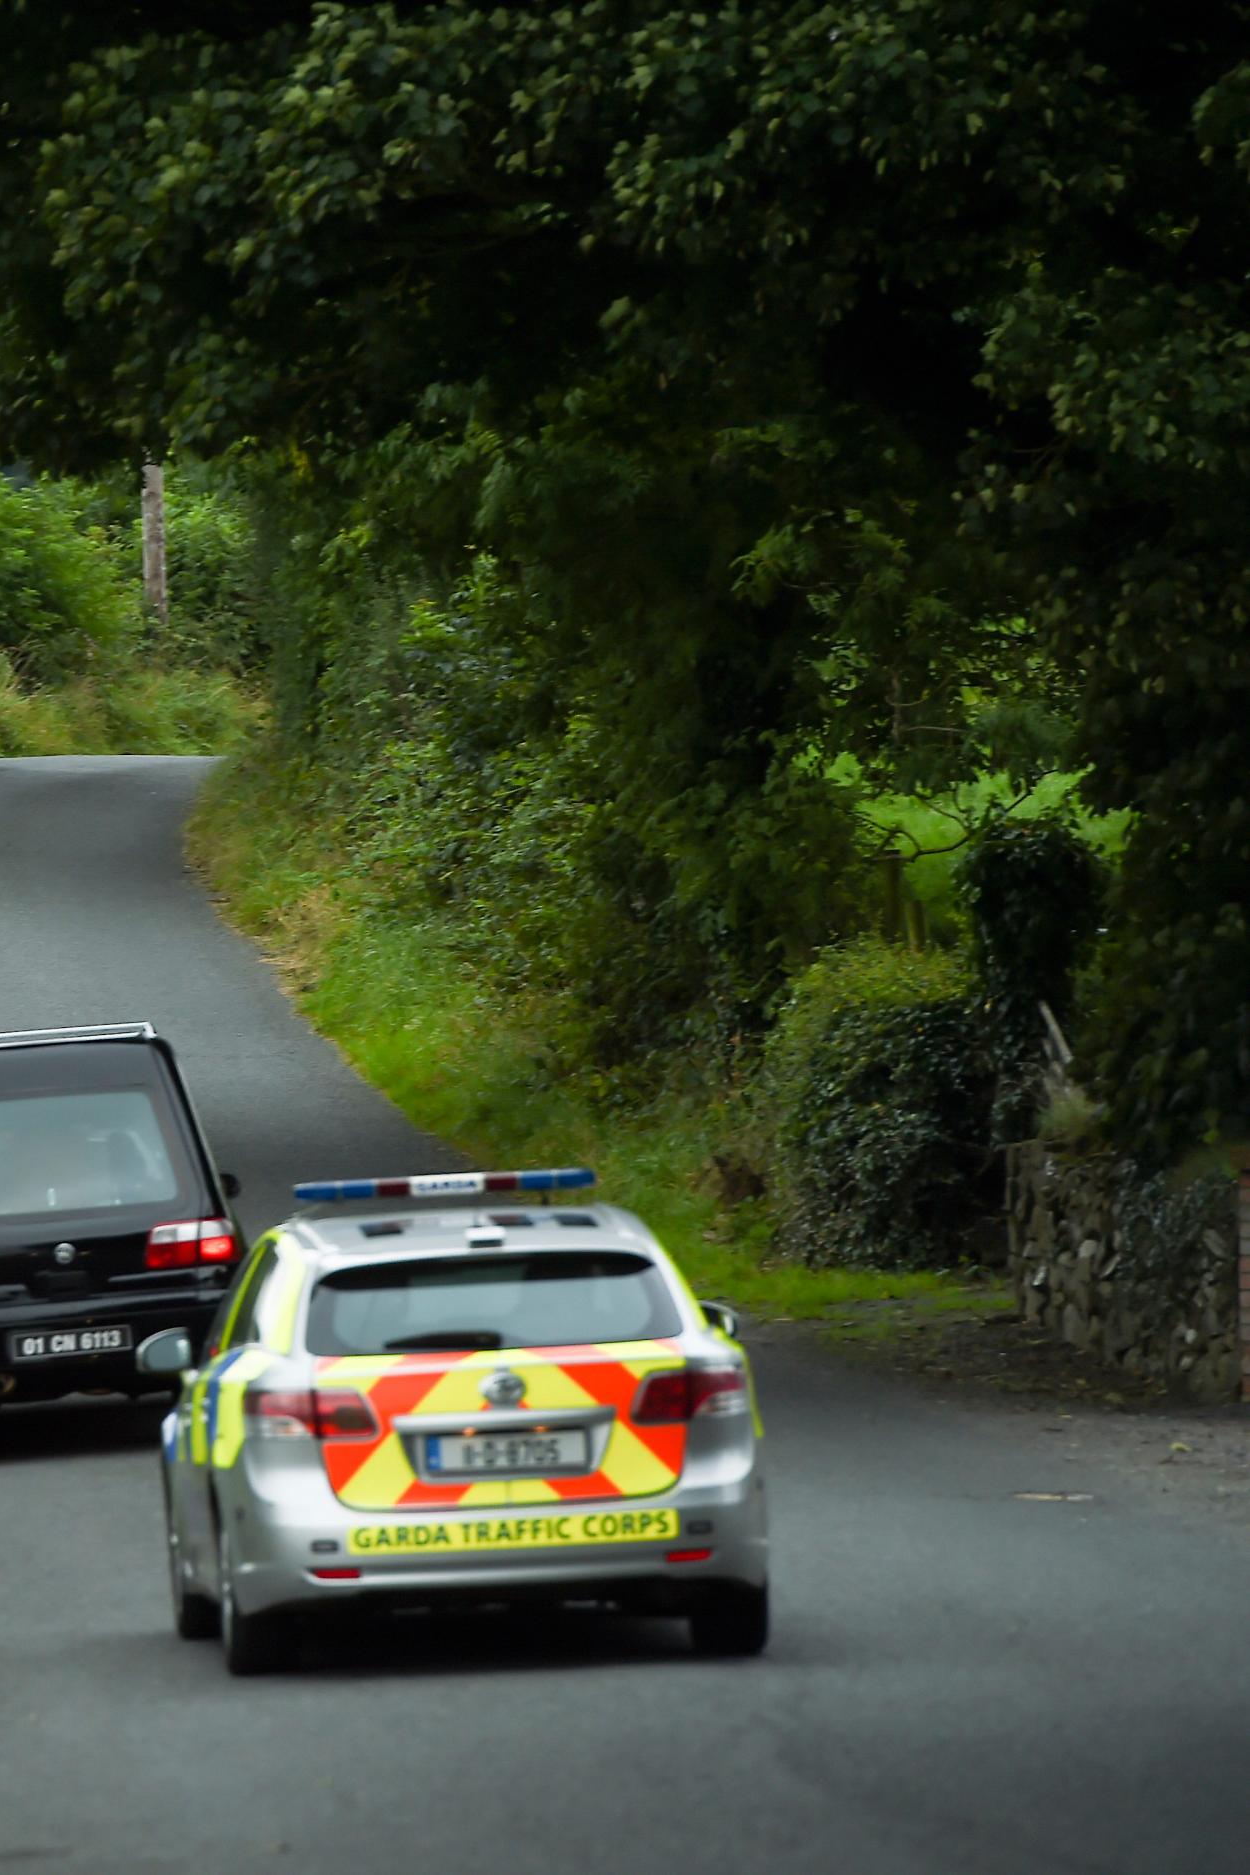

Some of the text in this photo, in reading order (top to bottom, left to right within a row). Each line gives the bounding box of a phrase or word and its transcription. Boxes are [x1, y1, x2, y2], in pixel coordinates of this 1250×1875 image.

[23, 1337, 45, 1356] 01
[353, 1509, 670, 1549] GARDA TRAFFIC CORPS
